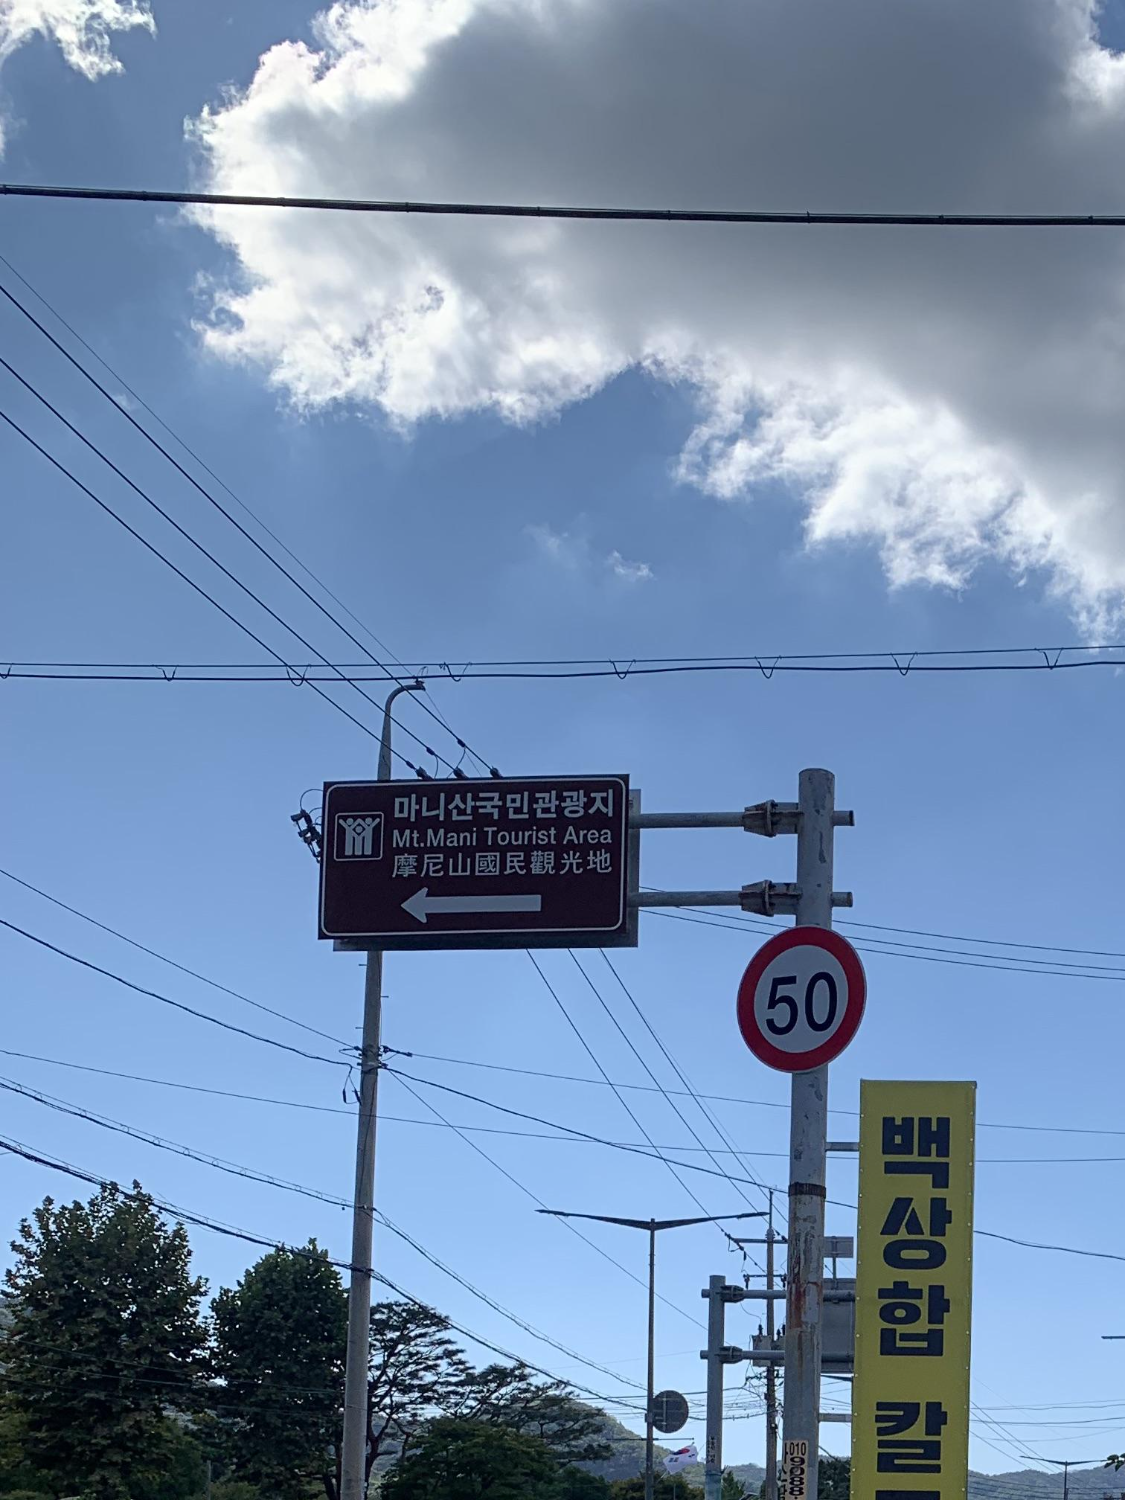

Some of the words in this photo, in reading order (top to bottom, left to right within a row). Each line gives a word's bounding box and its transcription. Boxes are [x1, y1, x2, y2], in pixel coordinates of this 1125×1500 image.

[393, 788, 614, 822] 마니산국민관광지
[392, 827, 477, 848] Mt.Mani
[483, 826, 557, 846] Tourist
[563, 825, 613, 845] Area
[392, 848, 613, 878] 摩尼山國民觀光地
[764, 970, 838, 1036] 50
[878, 1116, 953, 1357] 백상합
[789, 1442, 807, 1456] 010
